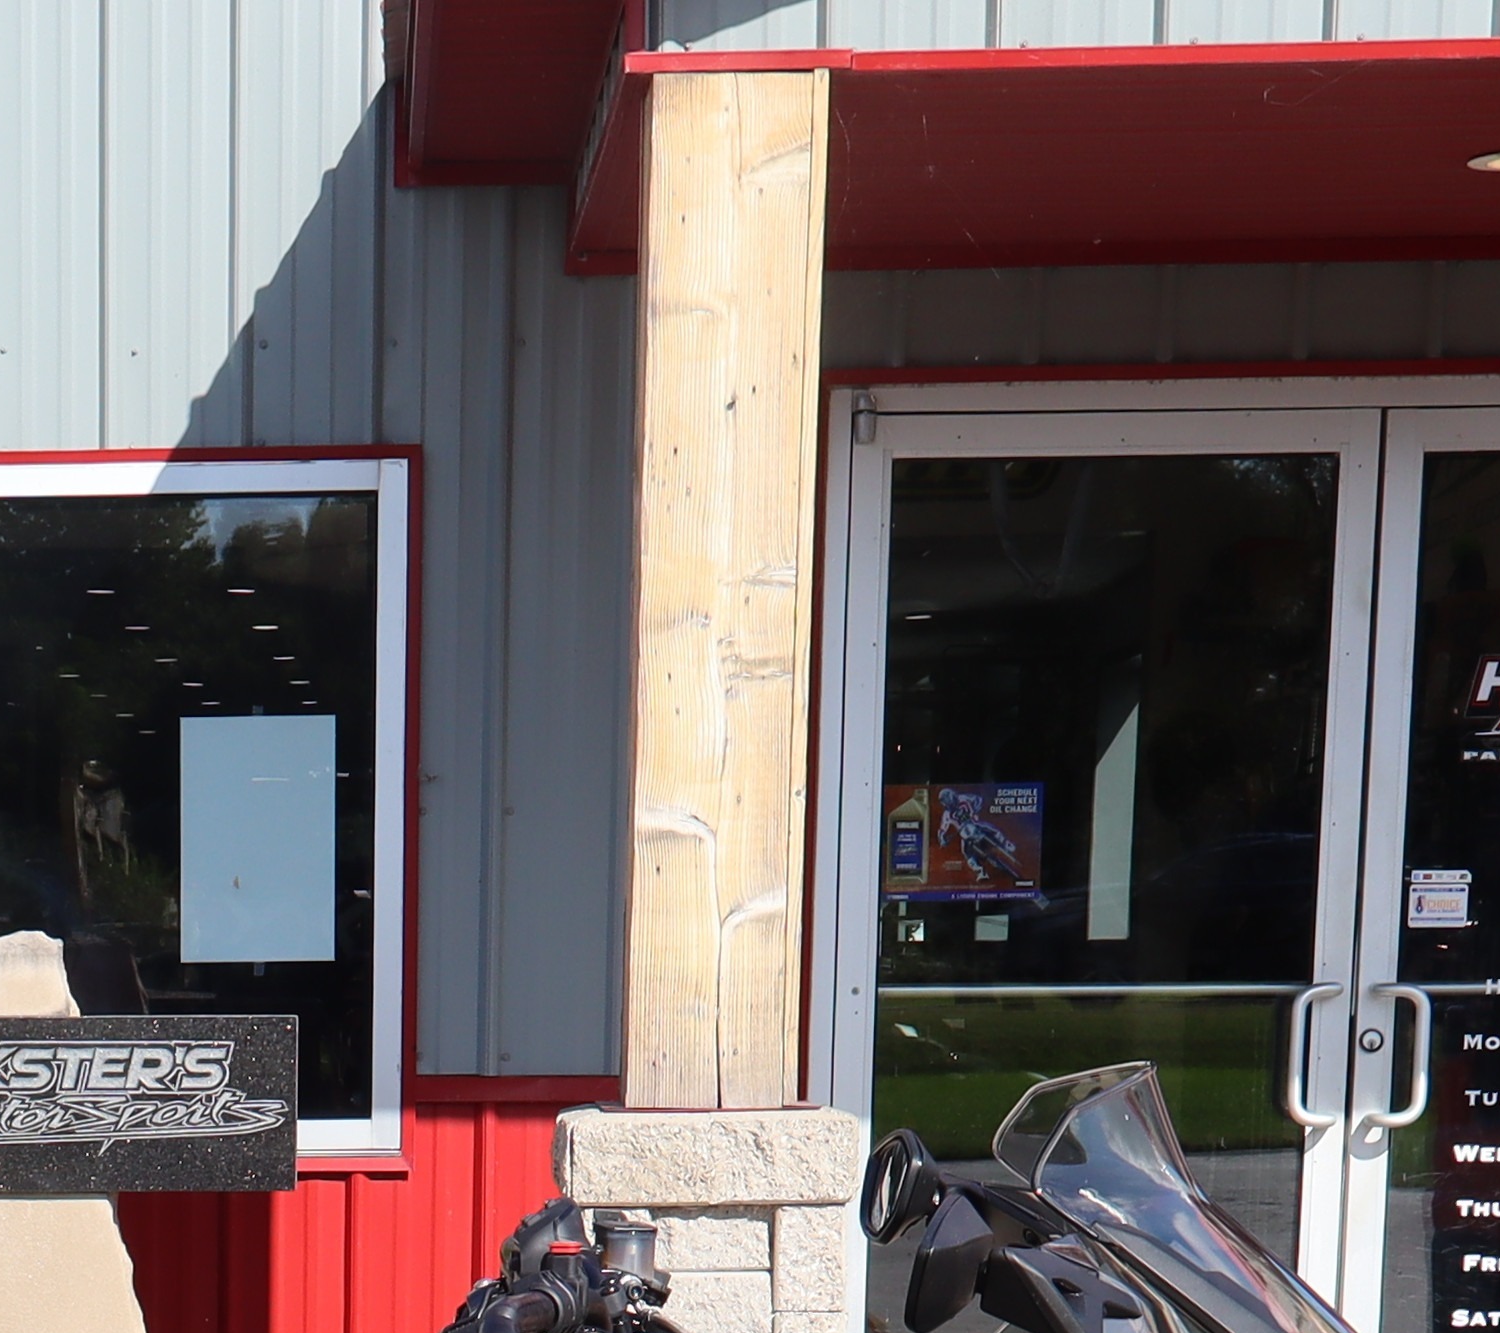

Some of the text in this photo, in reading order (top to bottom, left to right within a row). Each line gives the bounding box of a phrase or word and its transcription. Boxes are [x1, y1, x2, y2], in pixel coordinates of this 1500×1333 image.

[997, 788, 1038, 797] SCHEDULE
[994, 796, 1038, 805] YOUR NEXT
[1004, 804, 1038, 813] CHANGE
